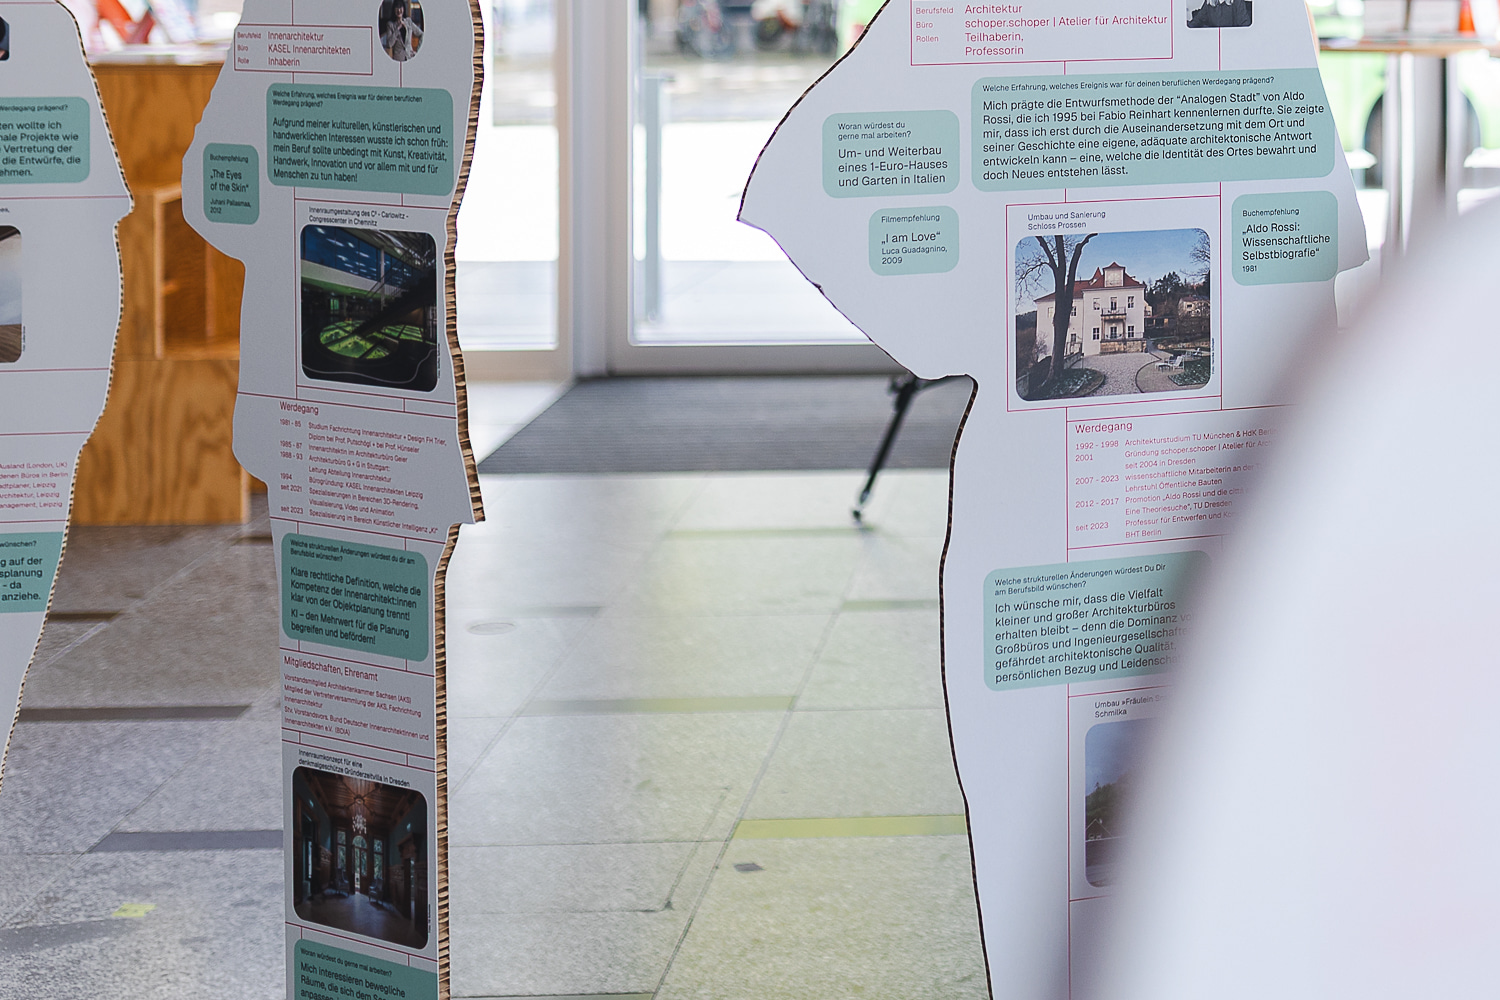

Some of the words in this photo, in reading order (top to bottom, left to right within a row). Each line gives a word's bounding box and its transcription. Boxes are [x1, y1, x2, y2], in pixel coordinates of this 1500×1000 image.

[965, 5, 1022, 13] Architektur
[965, 19, 1049, 28] schoper.schoper
[1059, 17, 1091, 25] Atelier
[1095, 16, 1109, 25] für
[1112, 16, 1167, 24] Architektur
[268, 32, 324, 41] Innenarchitektur
[965, 33, 1023, 41] Teilhaberin,
[268, 44, 291, 53] KASEL
[293, 46, 351, 54] Innenarchitekten
[966, 47, 1023, 55] Professorin
[268, 58, 300, 66] Inhaberin
[984, 101, 1007, 110] Mich
[1011, 100, 1044, 111] prägte
[1047, 99, 1062, 108] die
[1066, 97, 1155, 107] Entwurfsmethode
[1158, 96, 1174, 104] der
[1283, 92, 1304, 100] Aldo
[984, 115, 1013, 124] Rossi,
[1016, 114, 1032, 123] die
[1035, 113, 1049, 122] ich
[1053, 112, 1077, 122] 1995
[1081, 112, 1095, 121] bei
[1099, 111, 1126, 120] Fabio
[1129, 110, 1171, 119] Reinhart
[1174, 108, 1240, 117] kennenlernen
[1243, 106, 1274, 115] durfte.
[1277, 105, 1292, 114] Sie
[1295, 105, 1324, 115] zeigte
[273, 118, 305, 128] Aufgrund
[306, 120, 330, 128] meiner
[332, 121, 371, 131] kulturellen,
[372, 122, 425, 132] künstlerischen
[427, 125, 441, 134] und
[984, 129, 1002, 139] mir,
[1005, 129, 1029, 137] dass
[1032, 127, 1046, 136] ich
[1050, 128, 1070, 136] erst
[1072, 126, 1101, 135] durch
[1104, 125, 1119, 134] die
[1122, 123, 1223, 133] Auseinandersetzung
[1227, 120, 1242, 129] mit
[1245, 120, 1266, 128] dem
[1269, 119, 1284, 128] Ort
[1287, 118, 1304, 127] und
[20, 133, 60, 142] Projekte
[62, 133, 79, 141] wie
[273, 131, 327, 141] handwerklichen
[329, 134, 365, 143] Interessen
[395, 136, 405, 145] ich
[407, 138, 429, 146] schon
[431, 138, 448, 147] früh:
[983, 143, 1015, 152] seiner
[1018, 141, 1075, 150] Geschichte
[1078, 139, 1099, 148] eine
[1102, 139, 1138, 149] eigene,
[1141, 137, 1187, 146] adäquate
[1190, 134, 1271, 144] architektonische
[1274, 132, 1312, 141] Antwort
[4, 145, 54, 154] Vertretung
[57, 145, 73, 153] der
[839, 149, 861, 158] Um-
[865, 148, 884, 157] und
[888, 147, 941, 156] Weiterbau
[983, 156, 1039, 166] entwickeln
[1043, 155, 1067, 163] kann
[1080, 153, 1103, 163] eine,
[1106, 152, 1142, 161] welche
[1145, 150, 1159, 159] die
[1163, 149, 1204, 159] Identität
[1206, 148, 1224, 157] des
[1227, 147, 1253, 156] Ortes
[1257, 146, 1296, 155] bewahrt
[1299, 144, 1316, 153] und
[2, 157, 17, 165] die
[20, 156, 64, 164] Entwürfe,
[67, 156, 81, 164] die
[838, 163, 867, 172] eines
[870, 161, 948, 171] 1-Euro-Hauses
[226, 170, 242, 180] Eyes
[983, 170, 1008, 180] doch
[1012, 170, 1044, 178] Neues
[1048, 168, 1098, 177] entstehen
[1102, 166, 1128, 175] lässt.
[839, 177, 858, 186] und
[862, 176, 898, 185] Garten
[901, 175, 910, 184] in
[914, 174, 945, 183] Italien
[210, 182, 217, 190] of
[219, 183, 230, 191] the
[1271, 222, 1300, 232] Rossi:
[1242, 235, 1330, 246] Wissenschaftliche
[1075, 423, 1132, 433] Werdegang
[9, 558, 25, 566] auf
[10, 581, 22, 589] da
[1, 592, 41, 601] anziehe.
[996, 603, 1010, 613] Ich
[1014, 600, 1059, 610] wünsche
[1063, 596, 1081, 606] mir,
[1084, 595, 1107, 604] dass
[1111, 592, 1125, 601] die
[1128, 589, 1163, 599] Vielfalt
[996, 616, 1030, 626] kleiner
[1034, 612, 1052, 623] und
[1056, 610, 1089, 622] großer
[1092, 602, 1175, 616] Architekturbüros
[284, 657, 343, 674] Mitgliedschaften,
[345, 667, 378, 681] Ehrenamt
